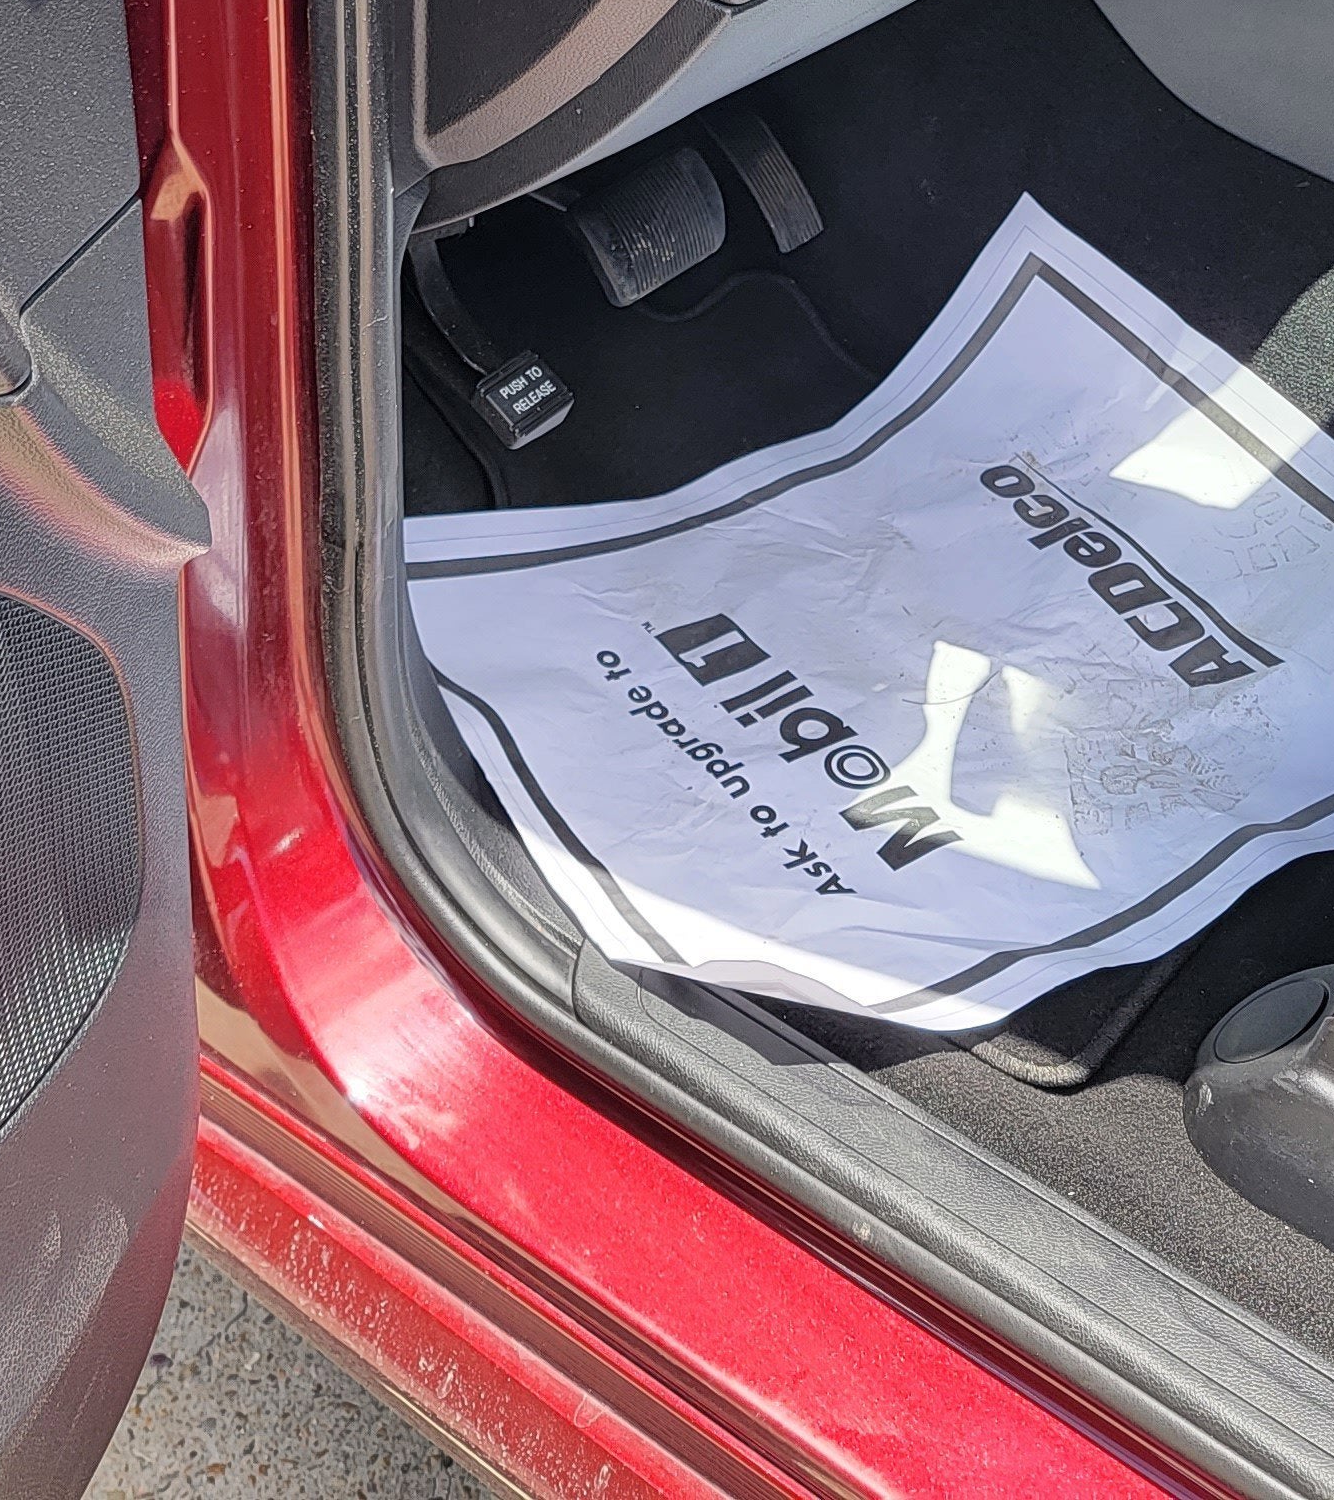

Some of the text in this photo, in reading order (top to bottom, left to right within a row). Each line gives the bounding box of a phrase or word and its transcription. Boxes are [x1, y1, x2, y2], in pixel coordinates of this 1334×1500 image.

[499, 366, 543, 400] PUSH TO
[512, 380, 557, 415] RELEASE
[980, 464, 1257, 688] ACDelco
[596, 649, 858, 896] Ask to upgrade to
[719, 669, 965, 872] Mobil
